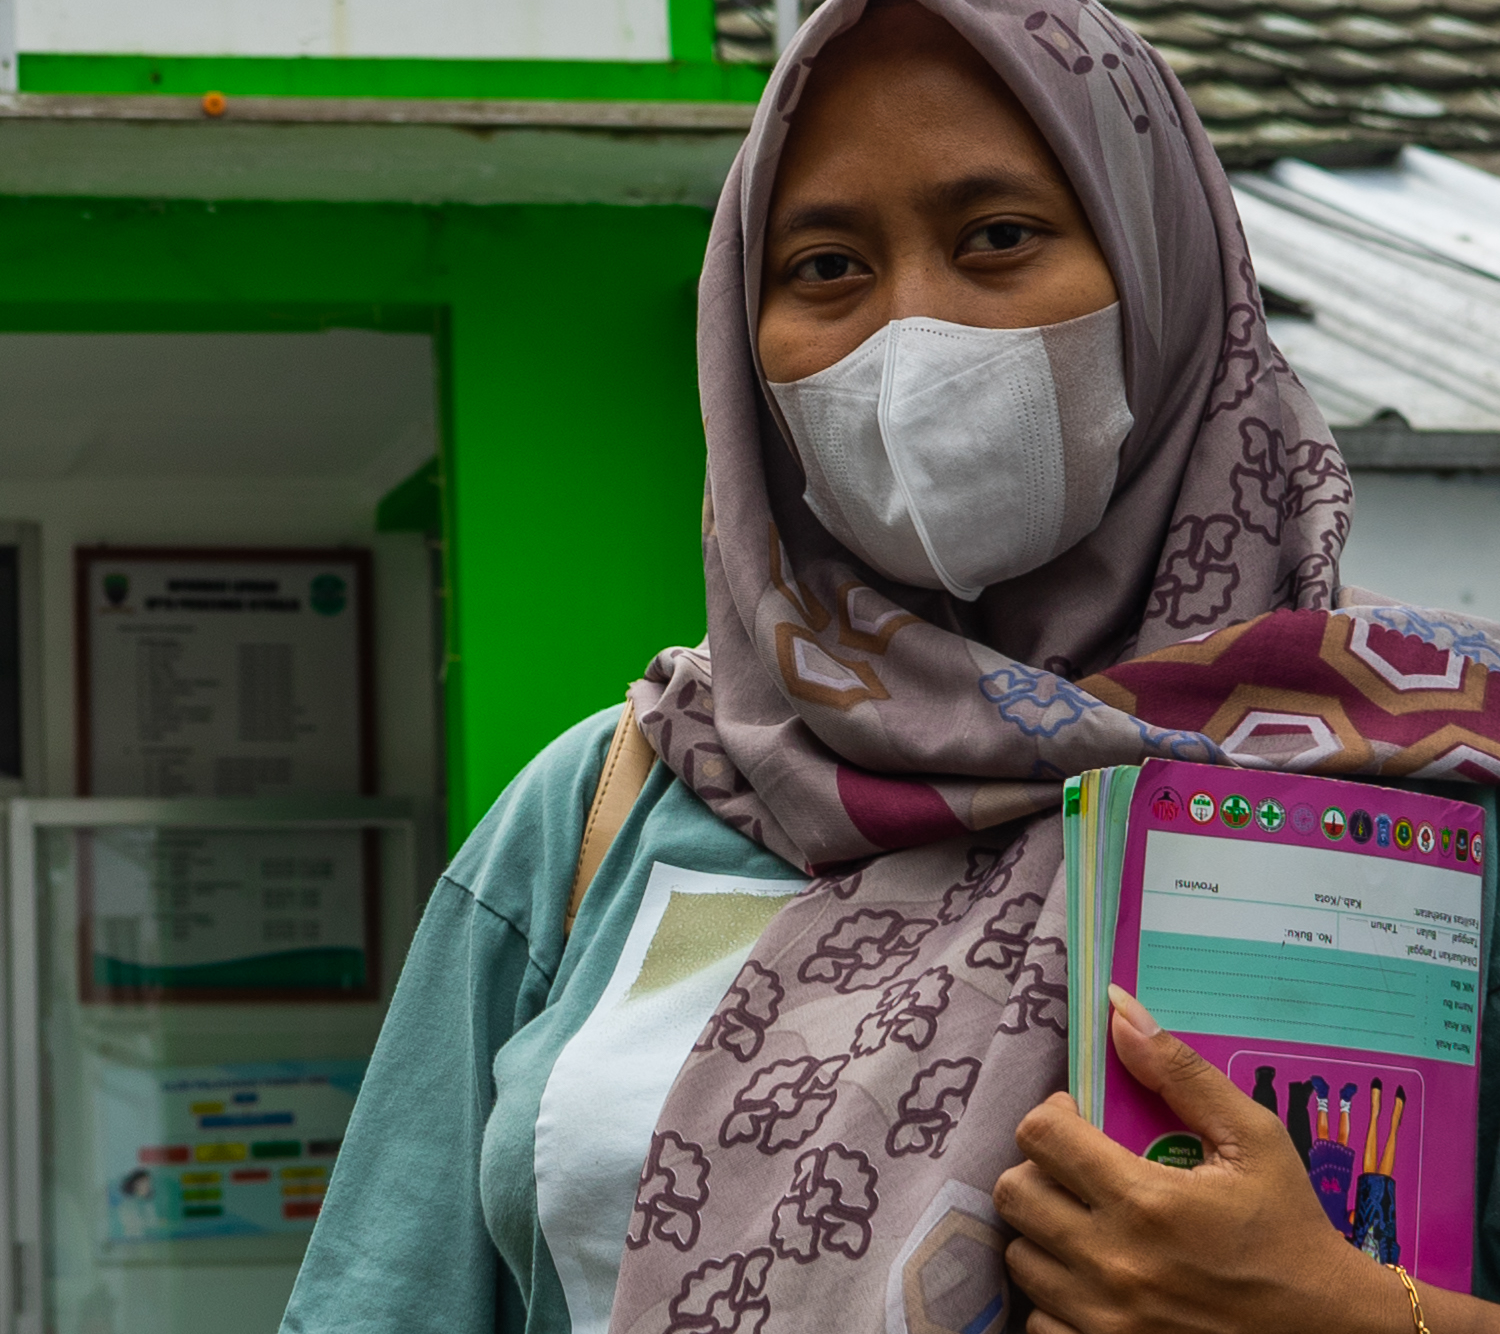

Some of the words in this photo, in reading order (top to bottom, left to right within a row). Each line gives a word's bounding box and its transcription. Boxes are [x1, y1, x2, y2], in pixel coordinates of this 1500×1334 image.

[1174, 879, 1219, 894] Provinsi
[1314, 894, 1362, 909] Kab./Kota
[1371, 920, 1398, 933] Tahun
[1454, 916, 1478, 929] Fasilitas
[1284, 929, 1313, 943] Buku:
[1316, 932, 1332, 944] No.
[1416, 928, 1436, 940] Bulan
[1452, 934, 1478, 948] Tanggal
[1438, 951, 1478, 967] Dikeluarkan
[1451, 980, 1461, 991] Ibu
[1462, 983, 1475, 993] NIK
[1443, 999, 1453, 1011] Ibu
[1455, 1001, 1473, 1013] Nama
[1444, 1020, 1459, 1031] Anak
[1460, 1024, 1472, 1034] NIK
[1435, 1039, 1452, 1050] Anak
[1454, 1043, 1470, 1054] Nama
